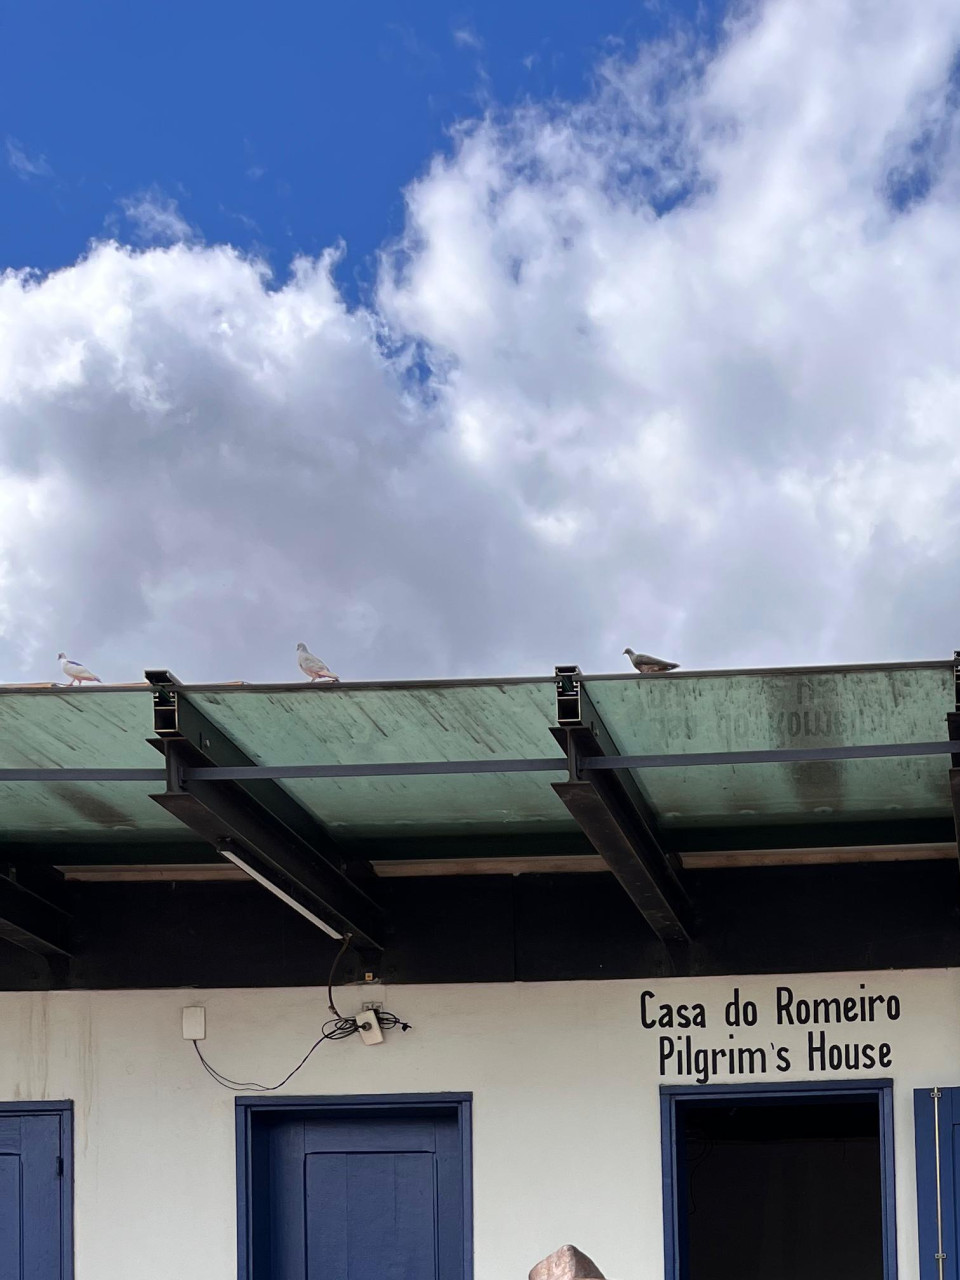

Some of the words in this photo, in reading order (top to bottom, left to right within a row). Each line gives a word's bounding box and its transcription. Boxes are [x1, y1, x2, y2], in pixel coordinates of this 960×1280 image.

[641, 991, 706, 1028] Casa
[725, 988, 757, 1026] do
[777, 984, 900, 1024] Romeiro
[659, 1034, 791, 1084] Pilgrim's
[808, 1031, 892, 1071] House
